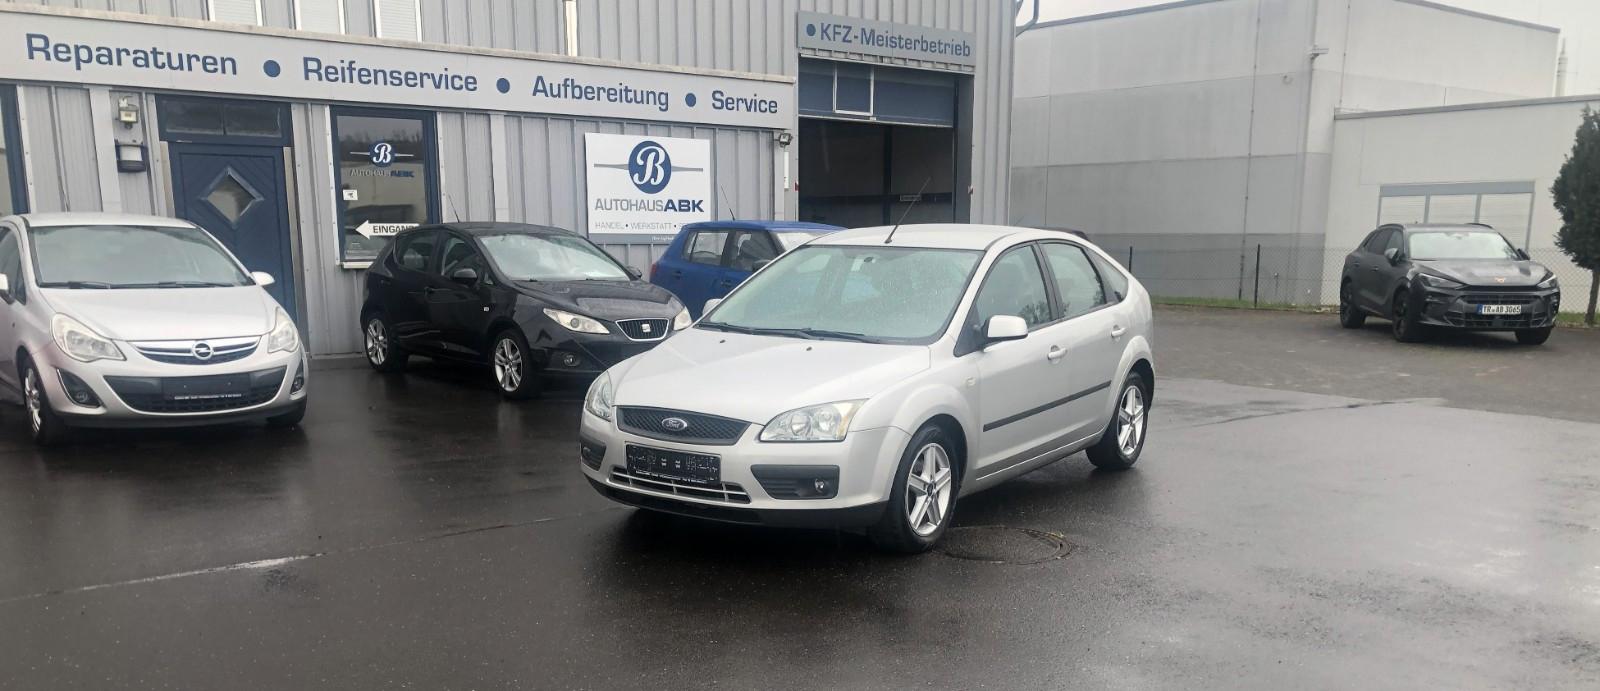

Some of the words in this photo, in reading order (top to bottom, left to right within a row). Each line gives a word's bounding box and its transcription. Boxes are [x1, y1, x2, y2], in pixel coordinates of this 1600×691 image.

[820, 22, 971, 57] KFZ-Meisterbetrieb
[26, 33, 238, 76] Reparaturen
[302, 56, 478, 92] Reifenservice
[532, 75, 670, 112] Aufbereitung
[711, 90, 779, 114] Service
[633, 145, 666, 186] B
[594, 198, 705, 213] AUTOHAUSABK
[630, 222, 672, 231] WERKSTATT
[1484, 305, 1492, 313] TR
